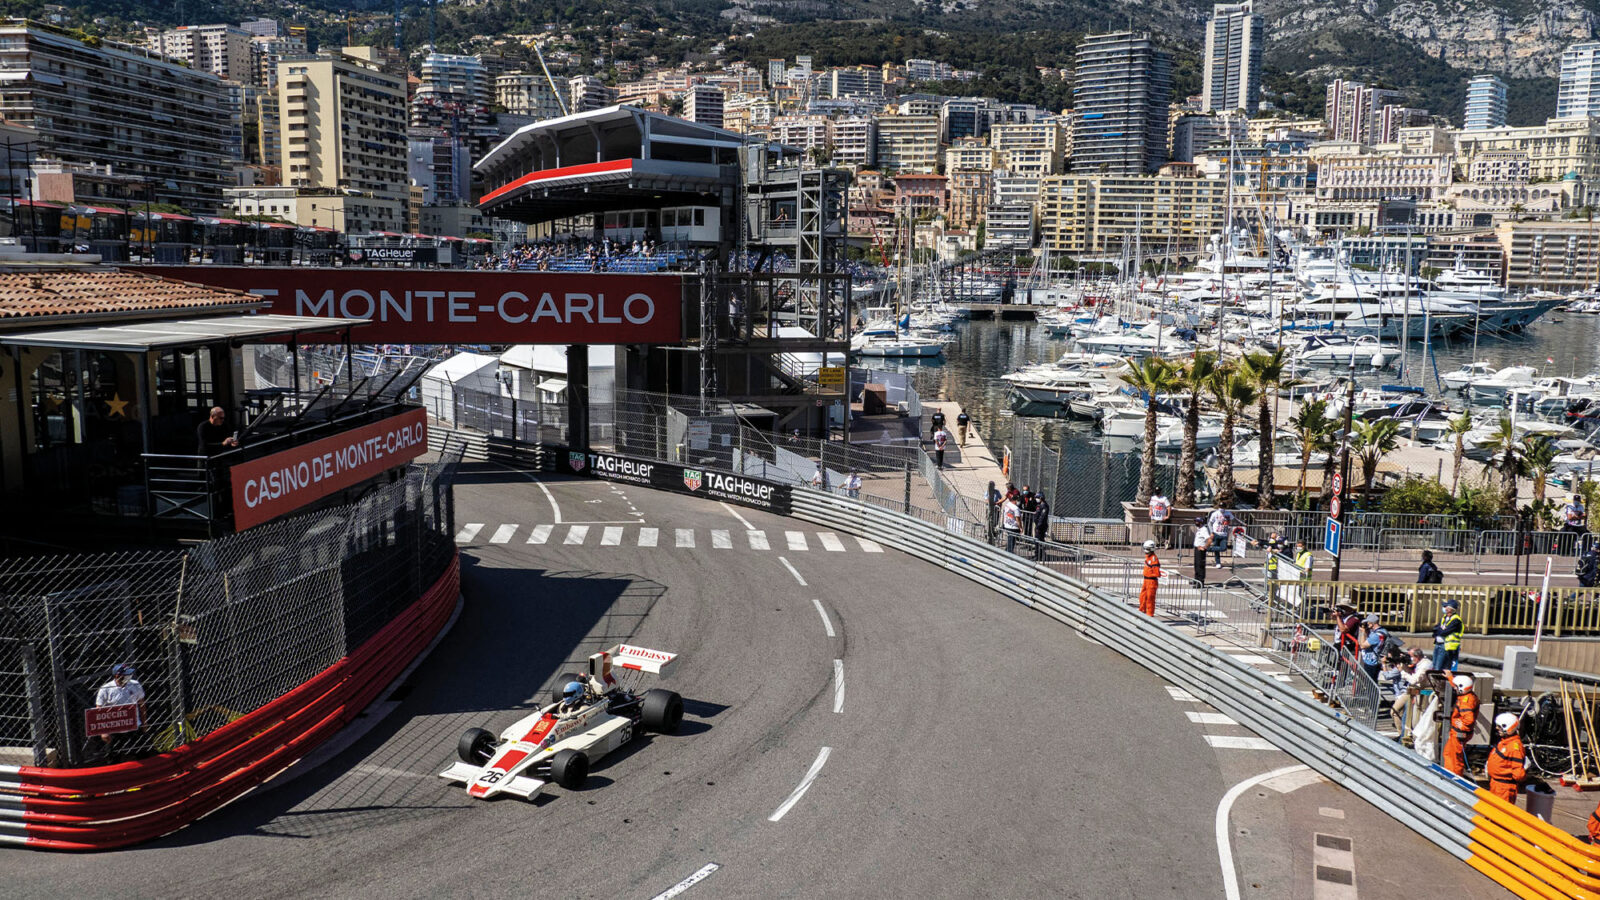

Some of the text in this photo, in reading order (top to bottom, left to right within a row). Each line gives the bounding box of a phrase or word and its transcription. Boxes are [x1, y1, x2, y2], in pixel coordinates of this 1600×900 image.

[295, 288, 655, 325] MONTE-CARLO
[244, 421, 423, 508] CASINO DE MONTE-CARLO
[96, 710, 127, 721] BOUCHE
[620, 724, 631, 744] 26
[479, 770, 504, 784] 26
